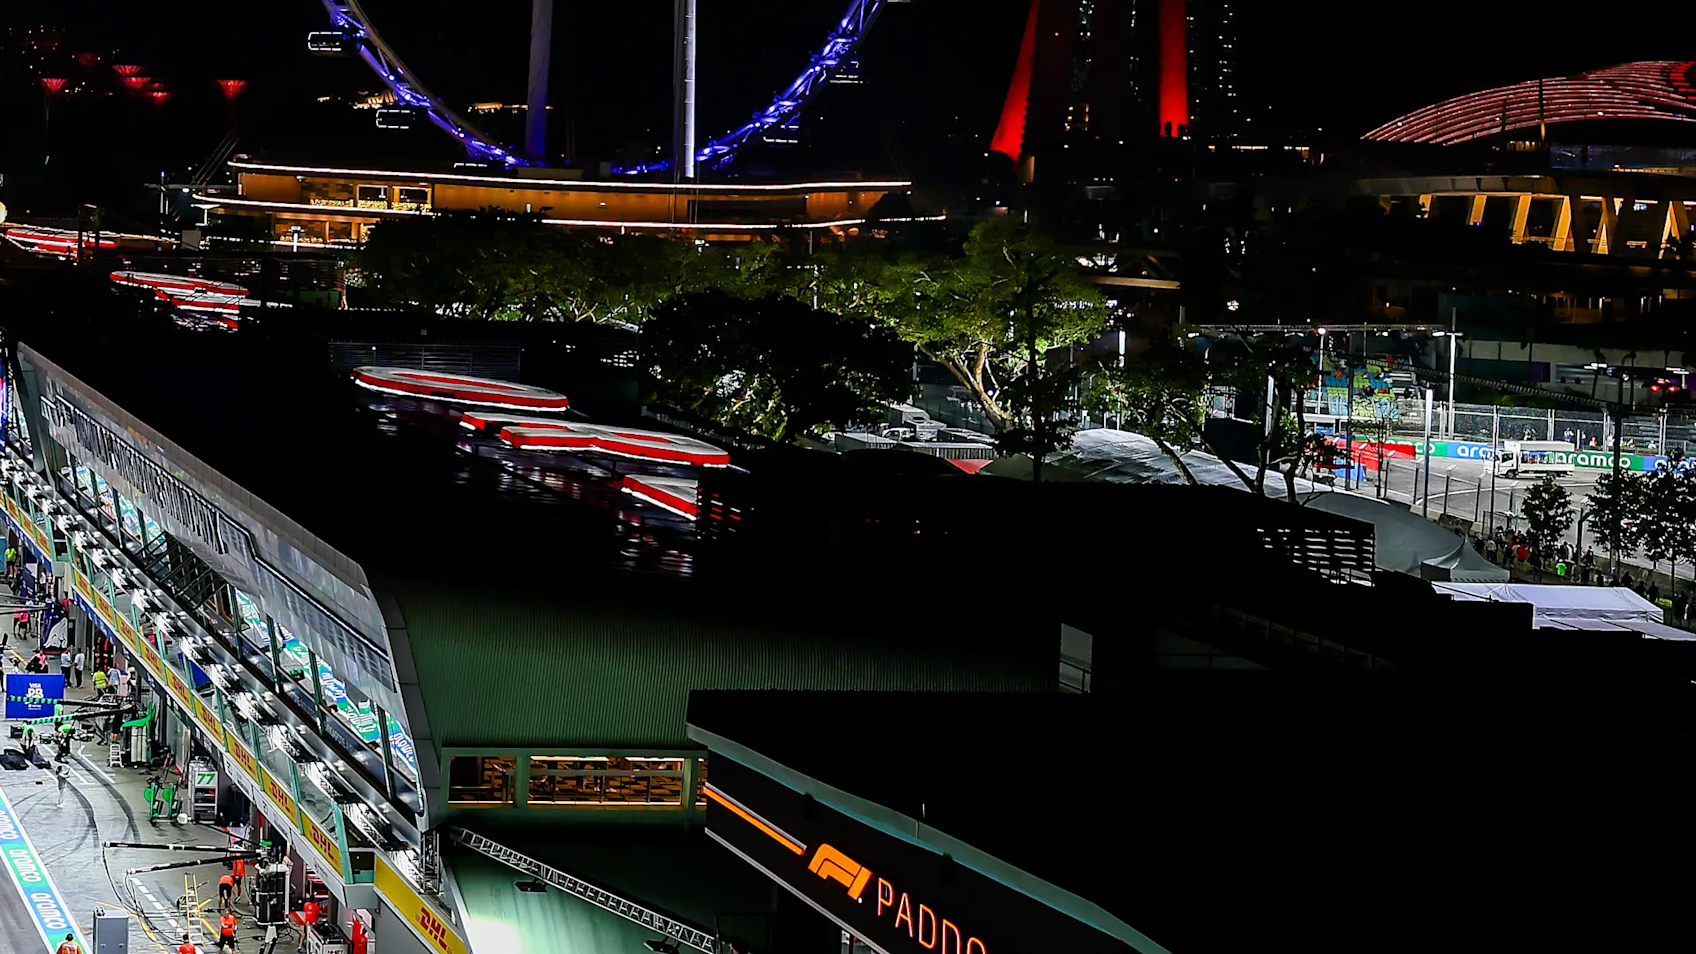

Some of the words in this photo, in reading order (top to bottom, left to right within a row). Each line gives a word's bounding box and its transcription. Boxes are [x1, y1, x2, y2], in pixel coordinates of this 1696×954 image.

[201, 706, 220, 734] DHL
[233, 743, 255, 773] DHL
[197, 773, 216, 785] 77
[270, 781, 292, 813] DHL
[311, 824, 334, 861] DHL
[8, 848, 43, 883] aramco
[30, 892, 68, 930] aramco
[418, 906, 448, 951] DHL
